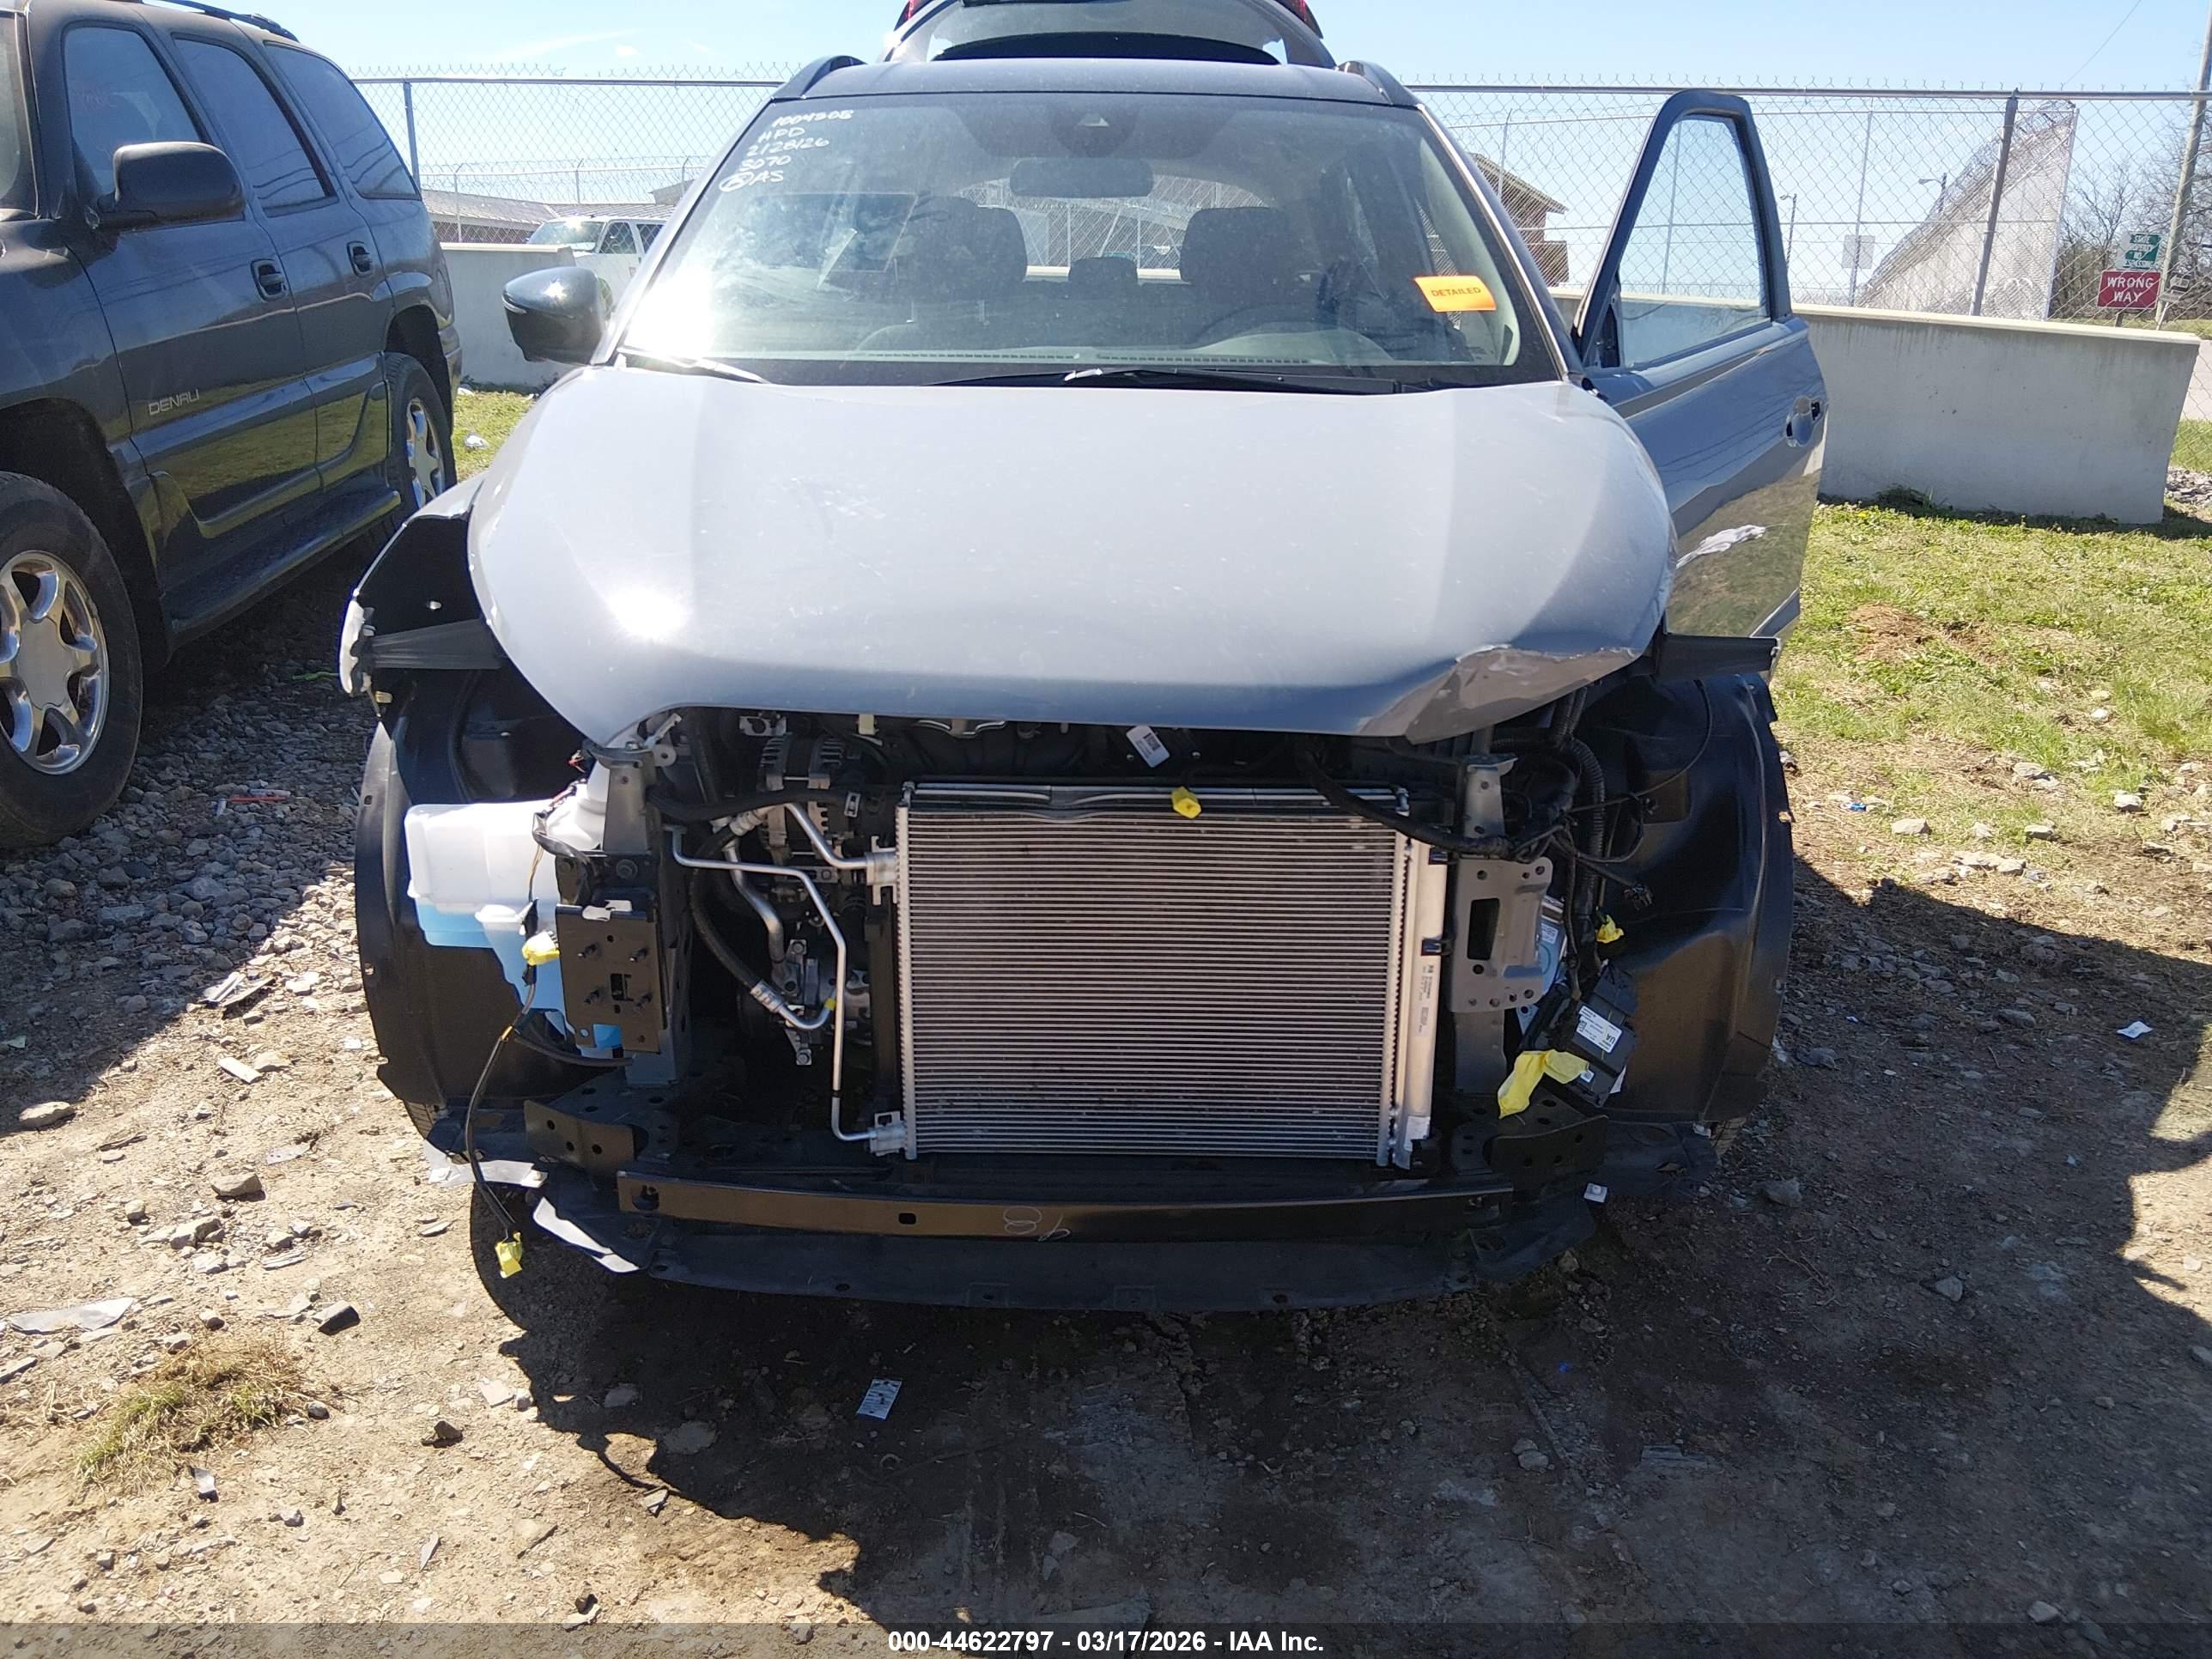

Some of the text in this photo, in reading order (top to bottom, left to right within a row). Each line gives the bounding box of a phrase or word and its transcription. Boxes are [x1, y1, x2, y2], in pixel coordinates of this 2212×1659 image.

[2107, 276, 2154, 289] WRONG
[1431, 287, 1481, 297] DETAILED
[2113, 291, 2142, 302] WAY
[149, 388, 199, 416] DENALI
